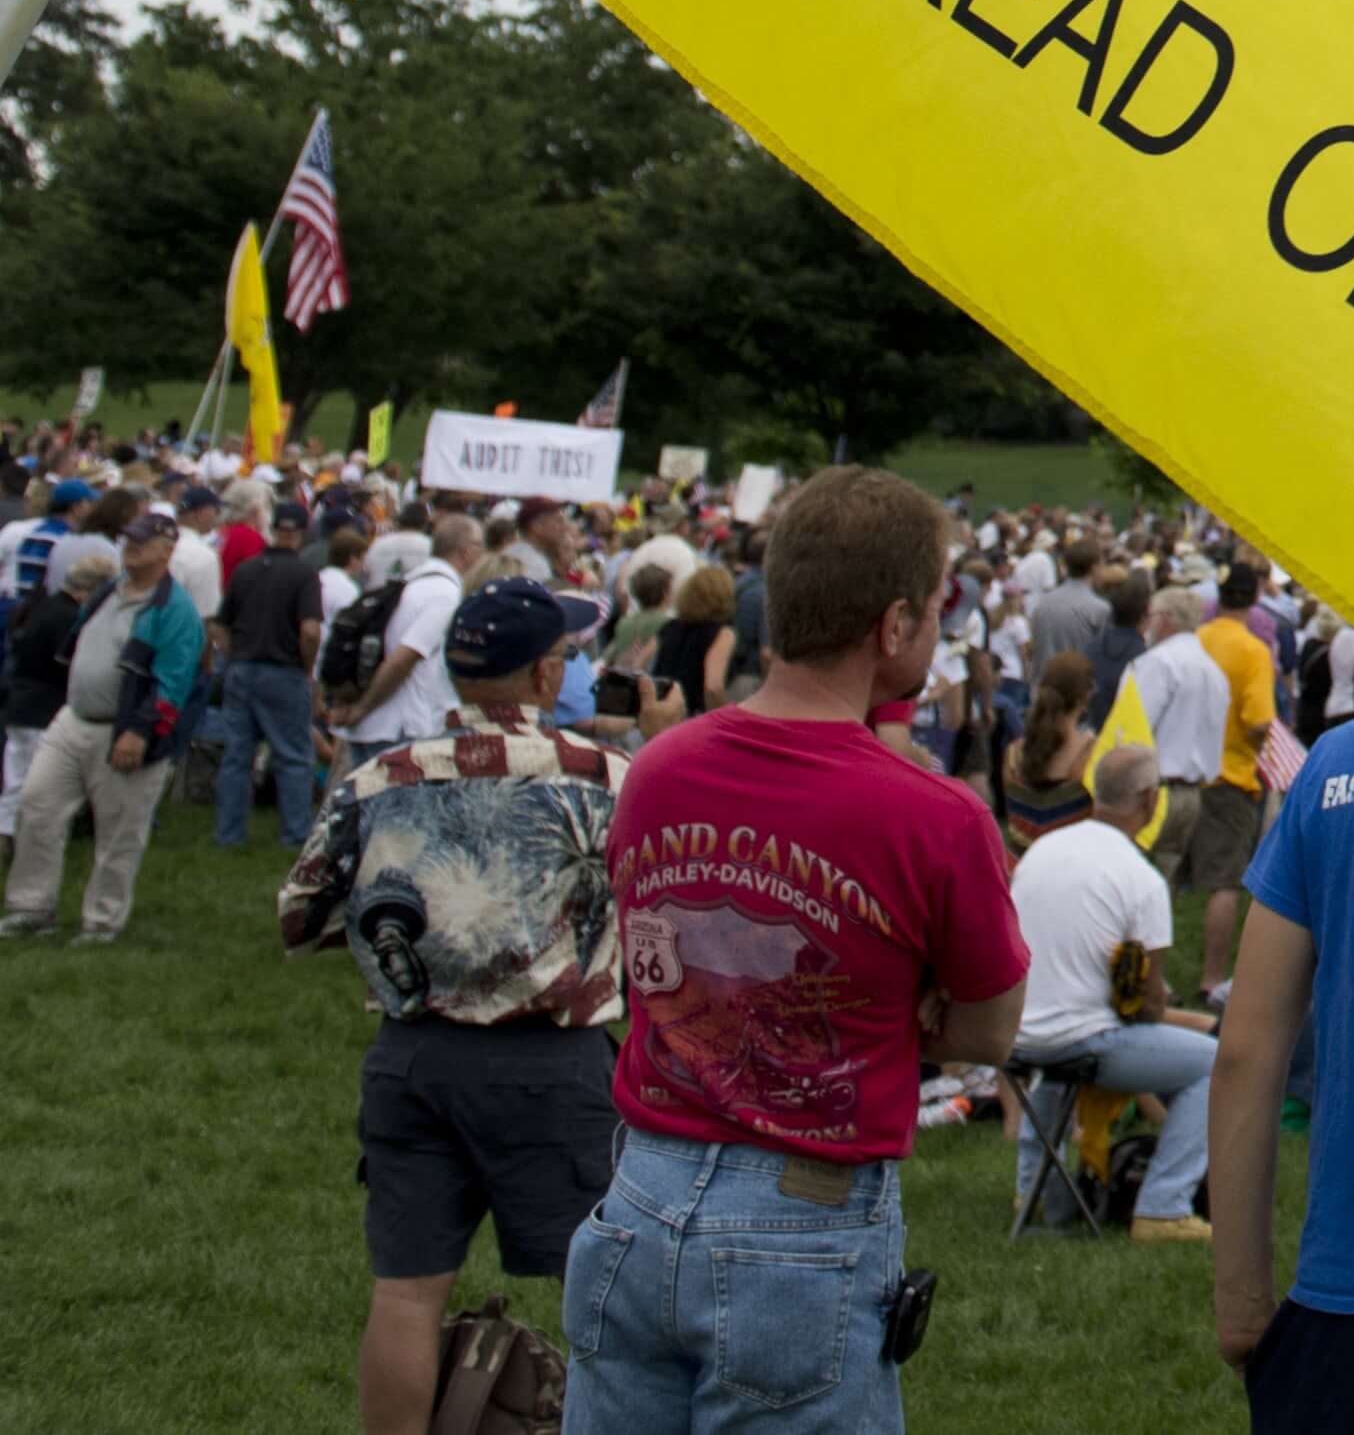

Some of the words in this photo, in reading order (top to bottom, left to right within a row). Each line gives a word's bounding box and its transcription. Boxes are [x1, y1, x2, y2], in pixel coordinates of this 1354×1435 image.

[614, 823, 718, 886] RAND
[728, 825, 891, 935] CANYON
[636, 862, 839, 934] HARLEY-DAVIDSON
[633, 950, 664, 983] 66
